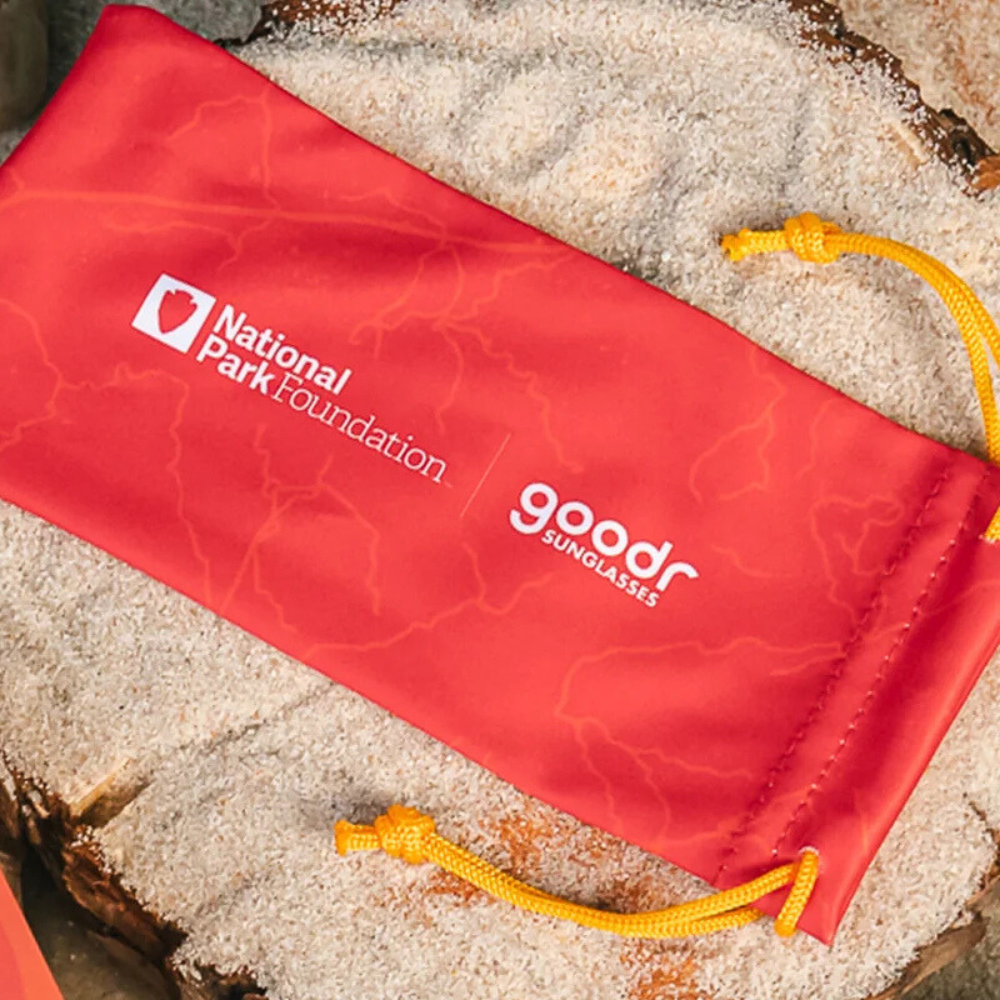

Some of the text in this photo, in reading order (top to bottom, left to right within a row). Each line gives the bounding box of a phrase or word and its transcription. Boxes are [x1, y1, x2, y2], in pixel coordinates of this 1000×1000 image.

[213, 304, 351, 395] National
[196, 334, 447, 484] Park Foundation
[509, 482, 699, 592] goodr
[541, 529, 660, 608] SUNGLASSES
